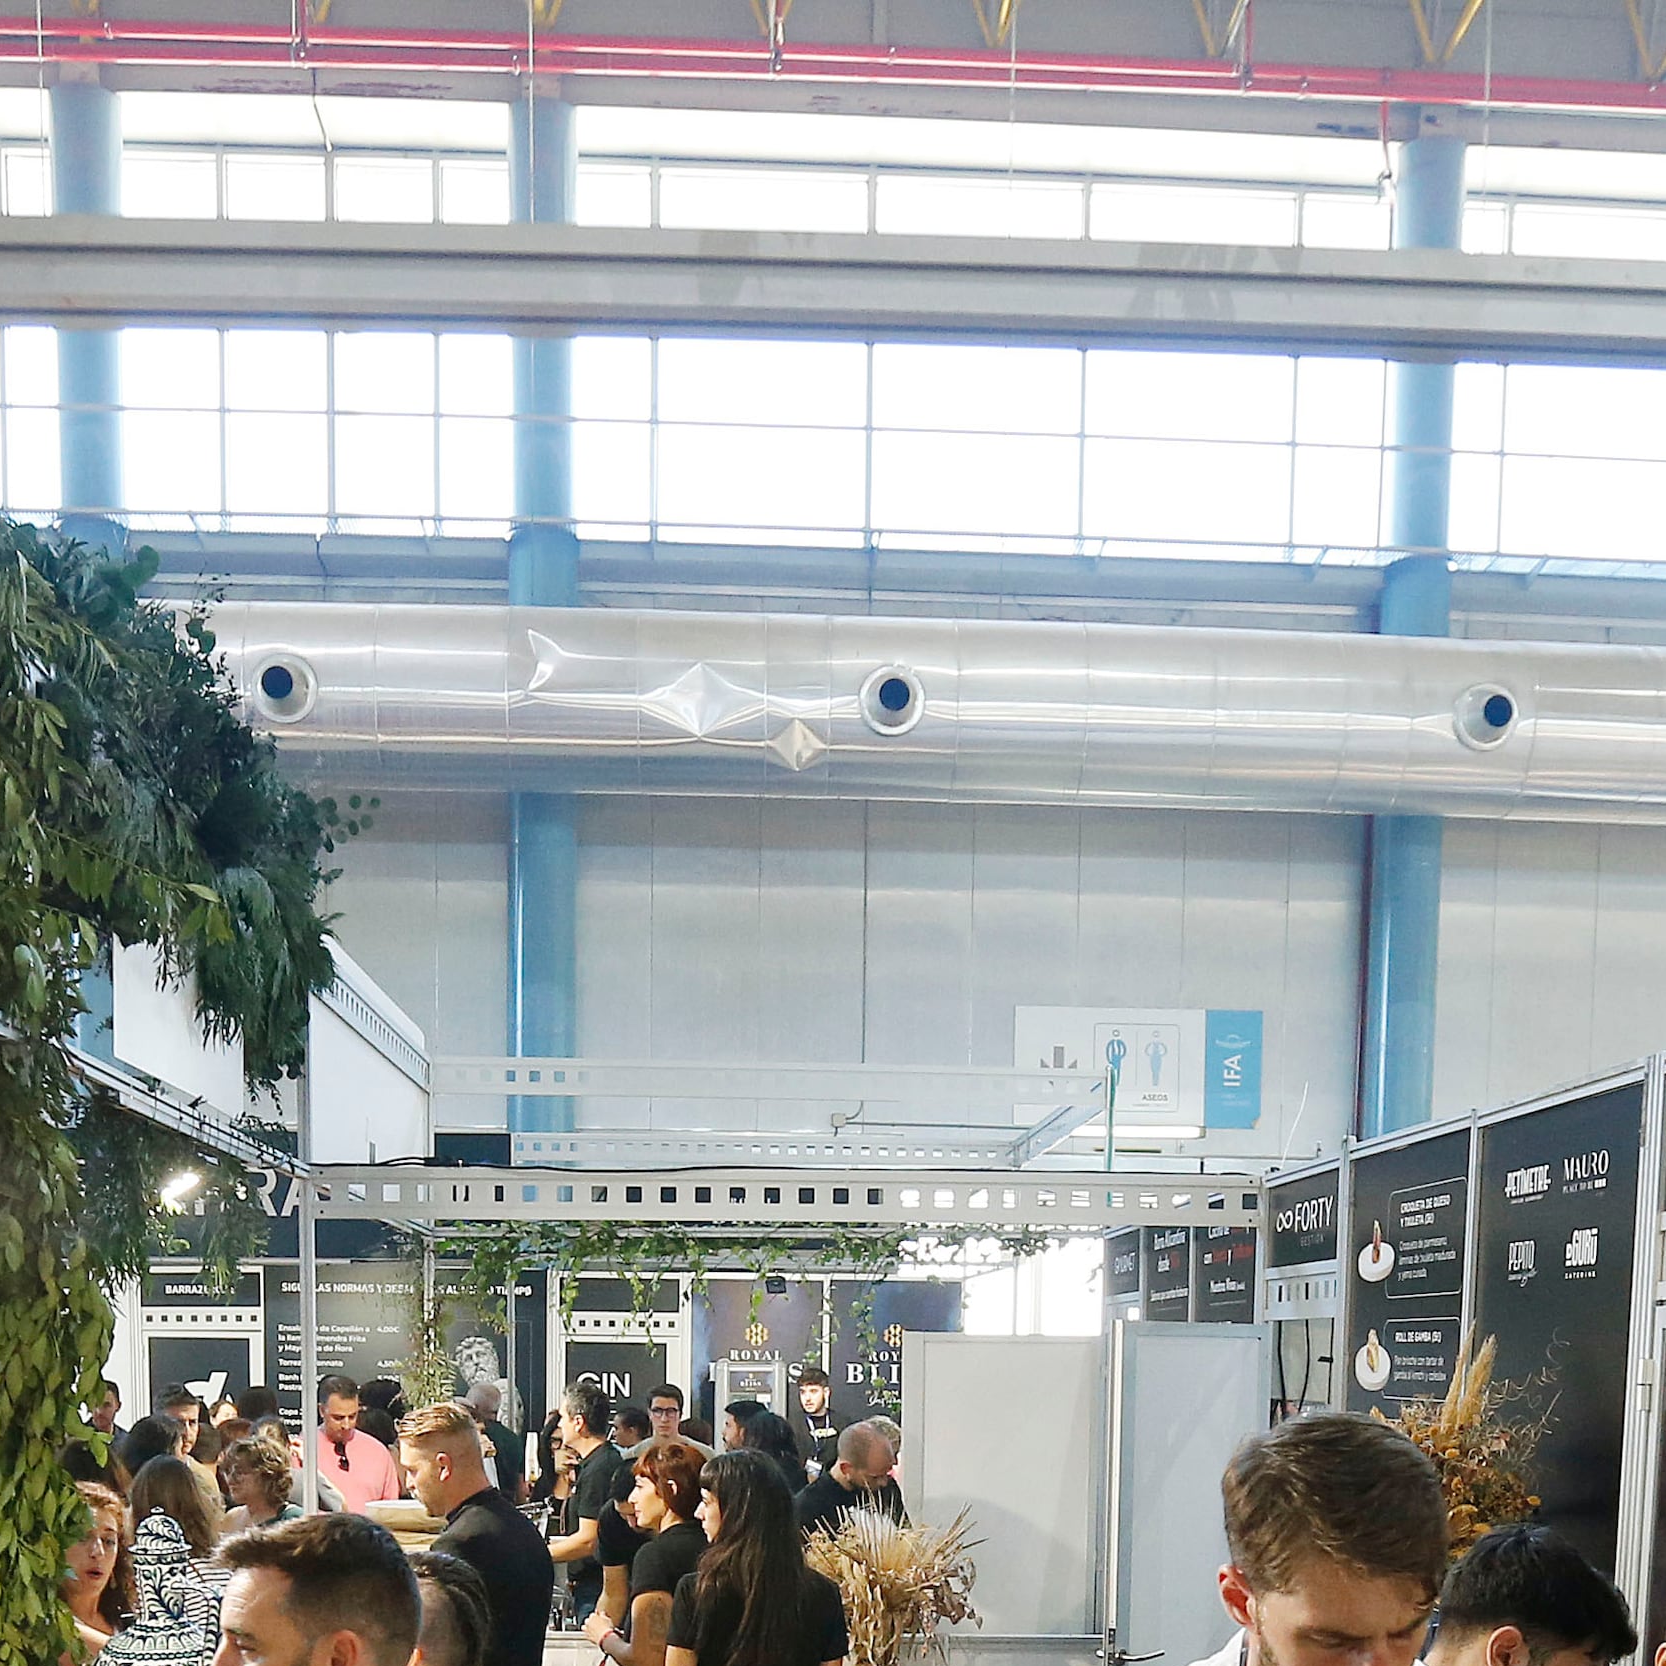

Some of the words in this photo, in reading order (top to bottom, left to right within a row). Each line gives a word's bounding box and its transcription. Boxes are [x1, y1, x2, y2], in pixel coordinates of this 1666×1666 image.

[1223, 1054, 1242, 1087] IFA
[1142, 1093, 1168, 1102] ASEOS
[1563, 1149, 1610, 1181] MAURO
[1294, 1194, 1333, 1234] FORTY
[1508, 1240, 1535, 1271] PEPITO
[332, 1282, 375, 1294] NORMAS
[376, 1283, 384, 1294] Y
[316, 1333, 348, 1343] lmendra
[729, 1349, 783, 1362] ROYAL
[869, 1350, 902, 1362] ROY
[846, 1361, 902, 1384] BLI
[576, 1372, 631, 1398] GIN
